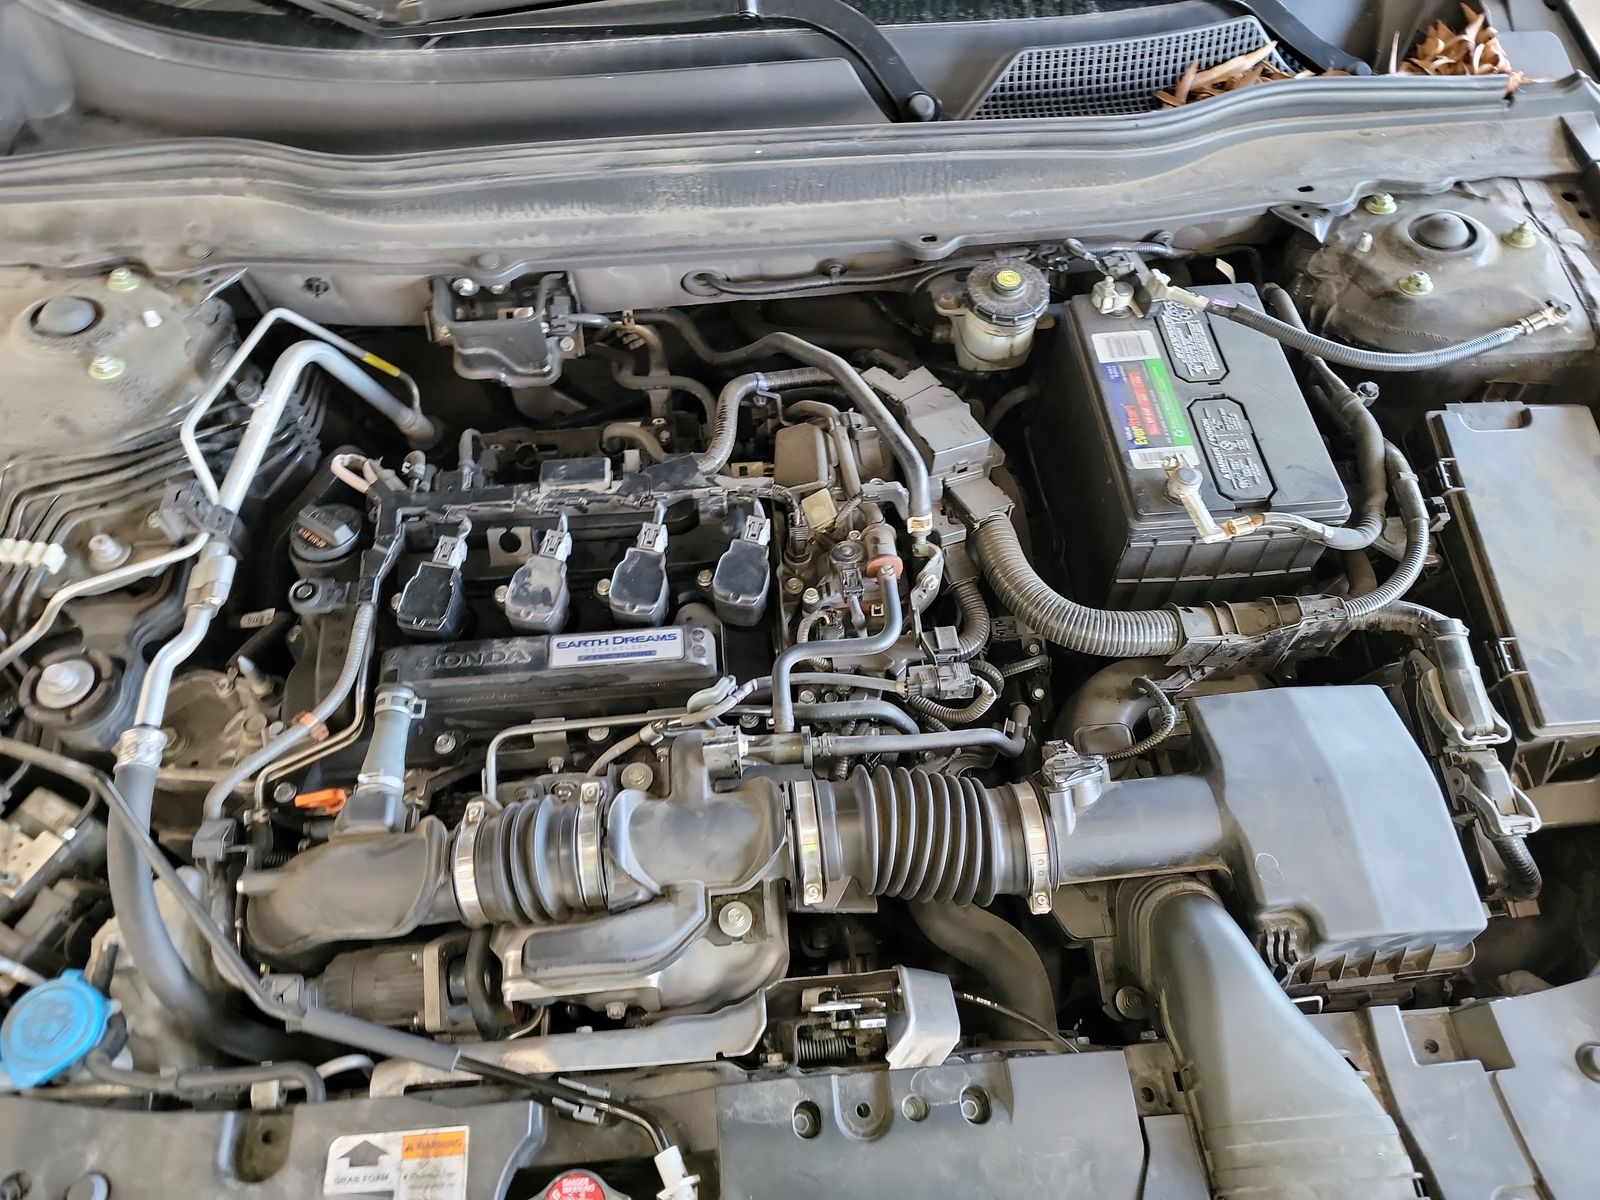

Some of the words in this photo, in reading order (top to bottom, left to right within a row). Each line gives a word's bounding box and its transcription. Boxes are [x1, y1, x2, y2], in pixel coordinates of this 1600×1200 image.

[1200, 418, 1216, 441] POISON
[1211, 447, 1229, 474] DANGER
[557, 638, 609, 649] EARTH
[613, 632, 678, 645] DREAMS
[415, 649, 532, 672] HONDA
[334, 1174, 359, 1184] GRAB
[362, 1173, 390, 1183] FOAM
